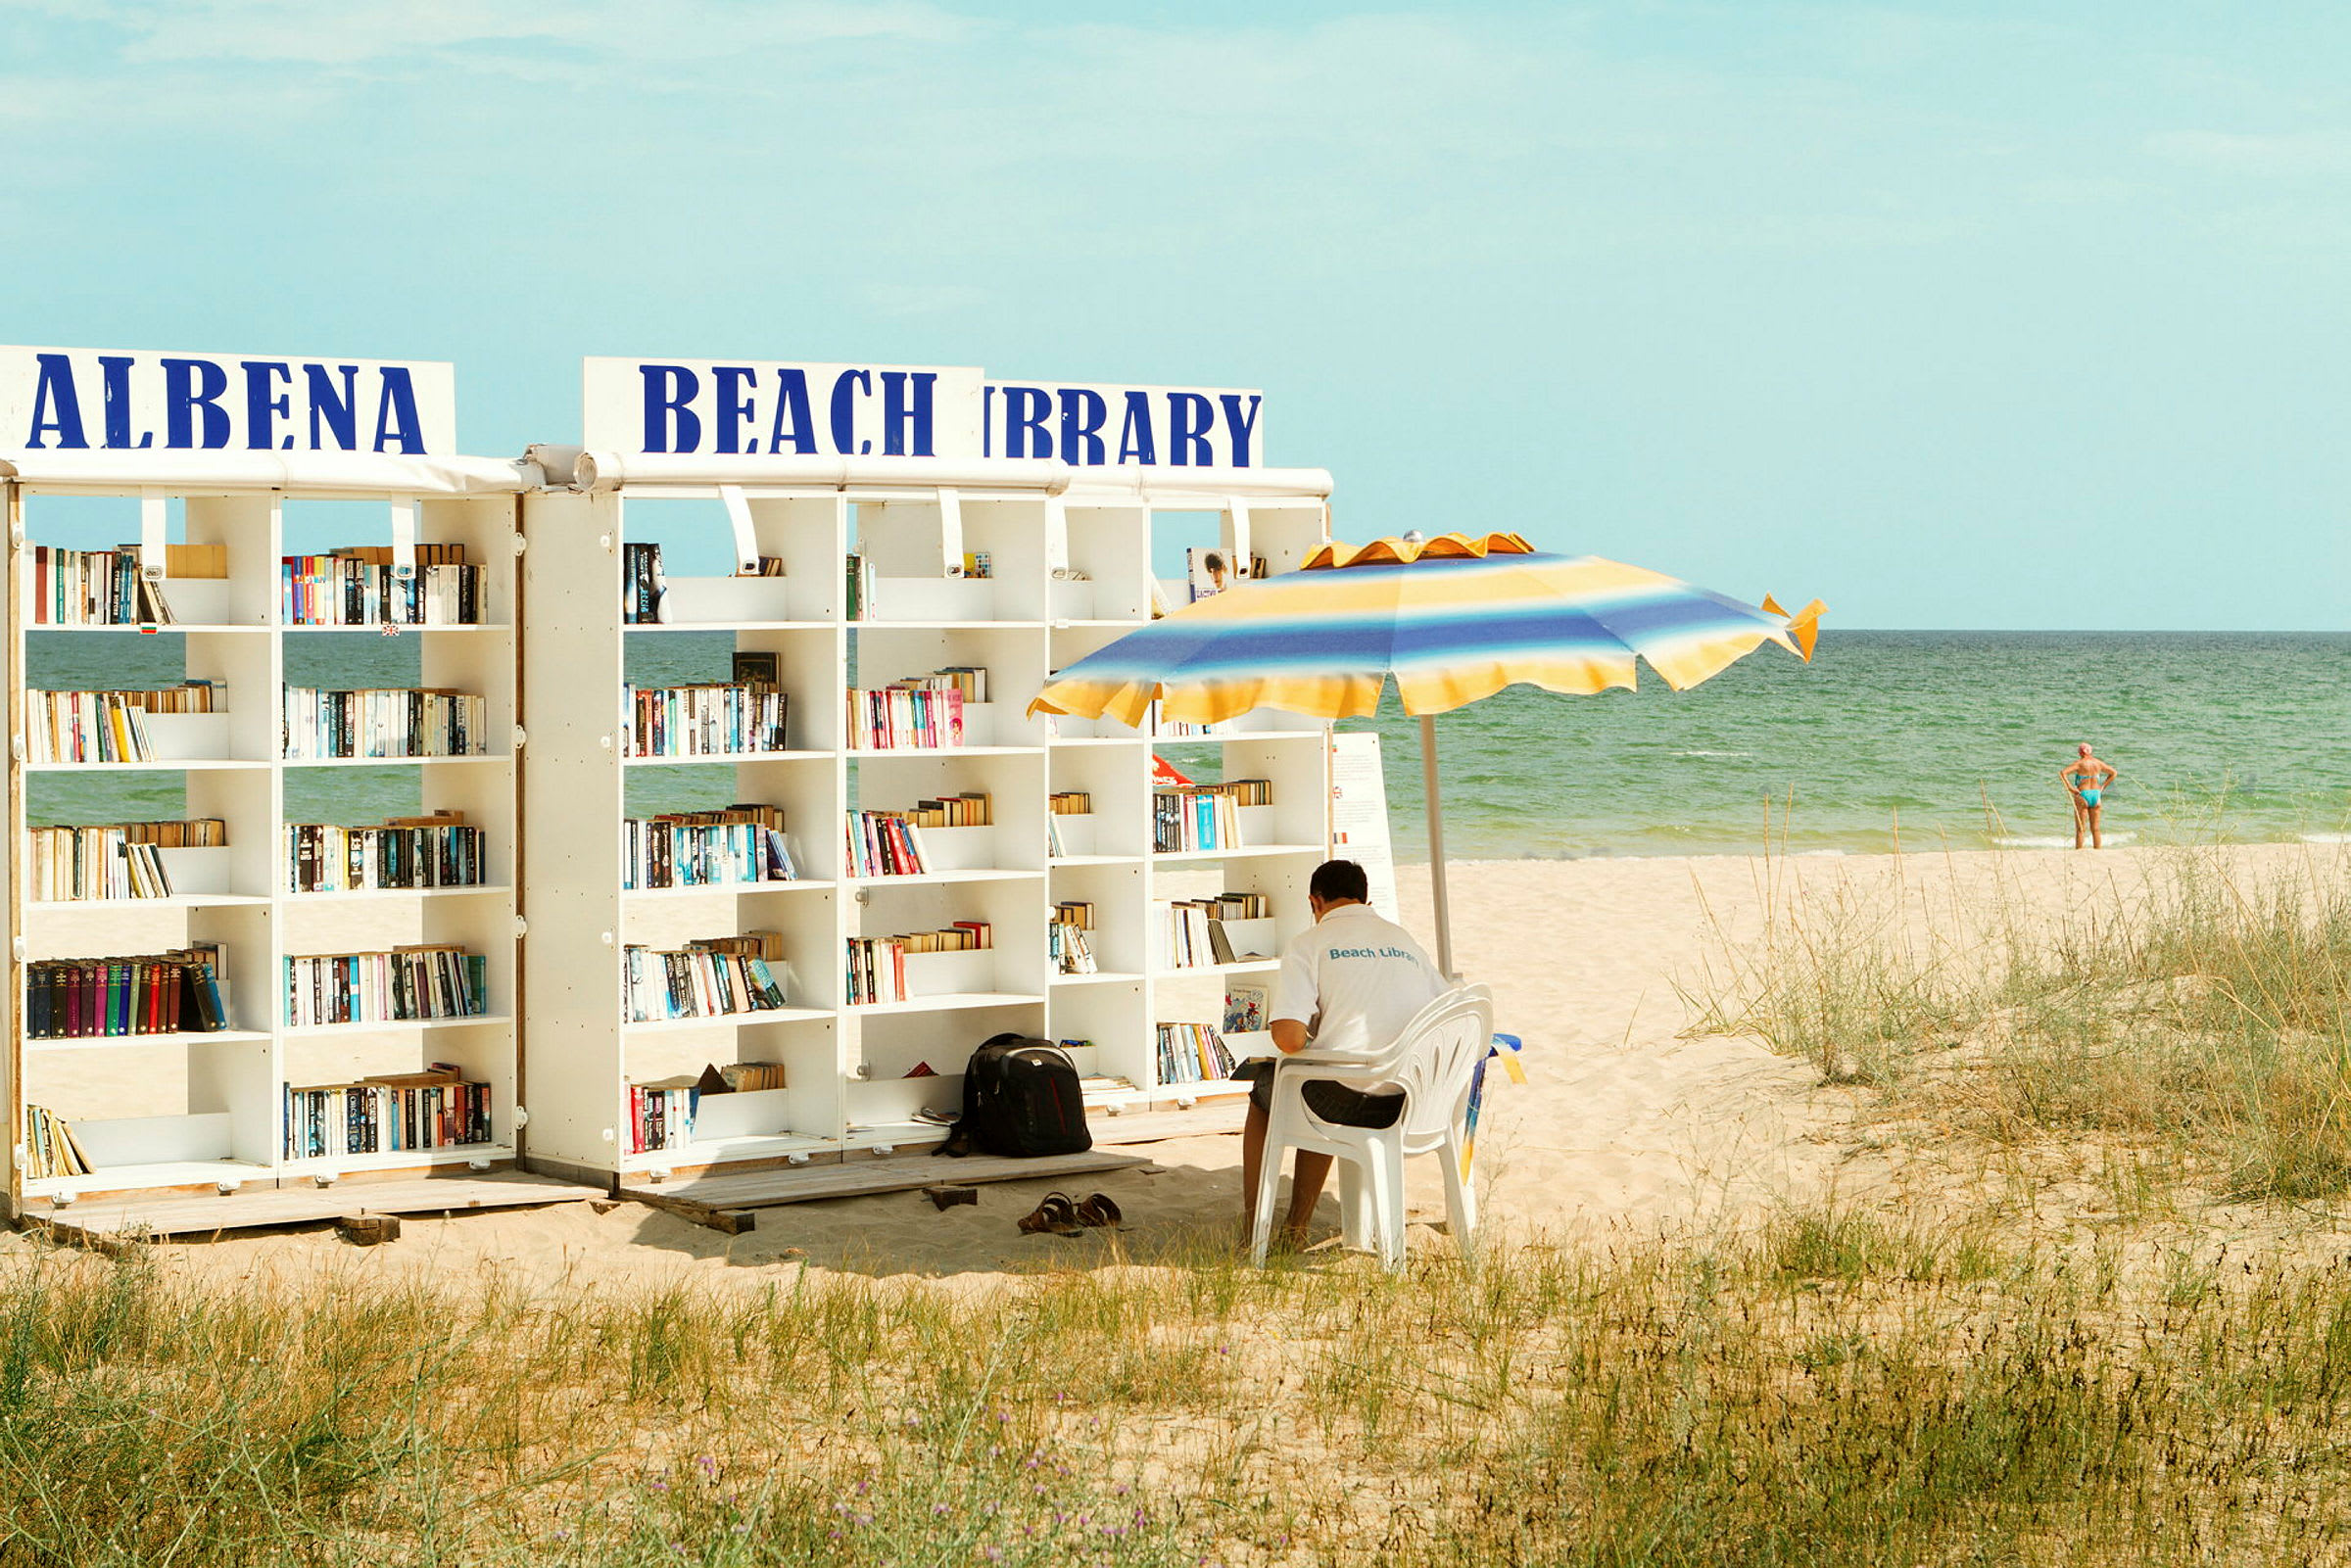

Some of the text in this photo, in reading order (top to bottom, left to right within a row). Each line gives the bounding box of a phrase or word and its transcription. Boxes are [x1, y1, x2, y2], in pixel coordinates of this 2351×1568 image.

[25, 354, 427, 454] ALBENA
[640, 365, 937, 456] BEACH
[1329, 948, 1375, 960] Beach
